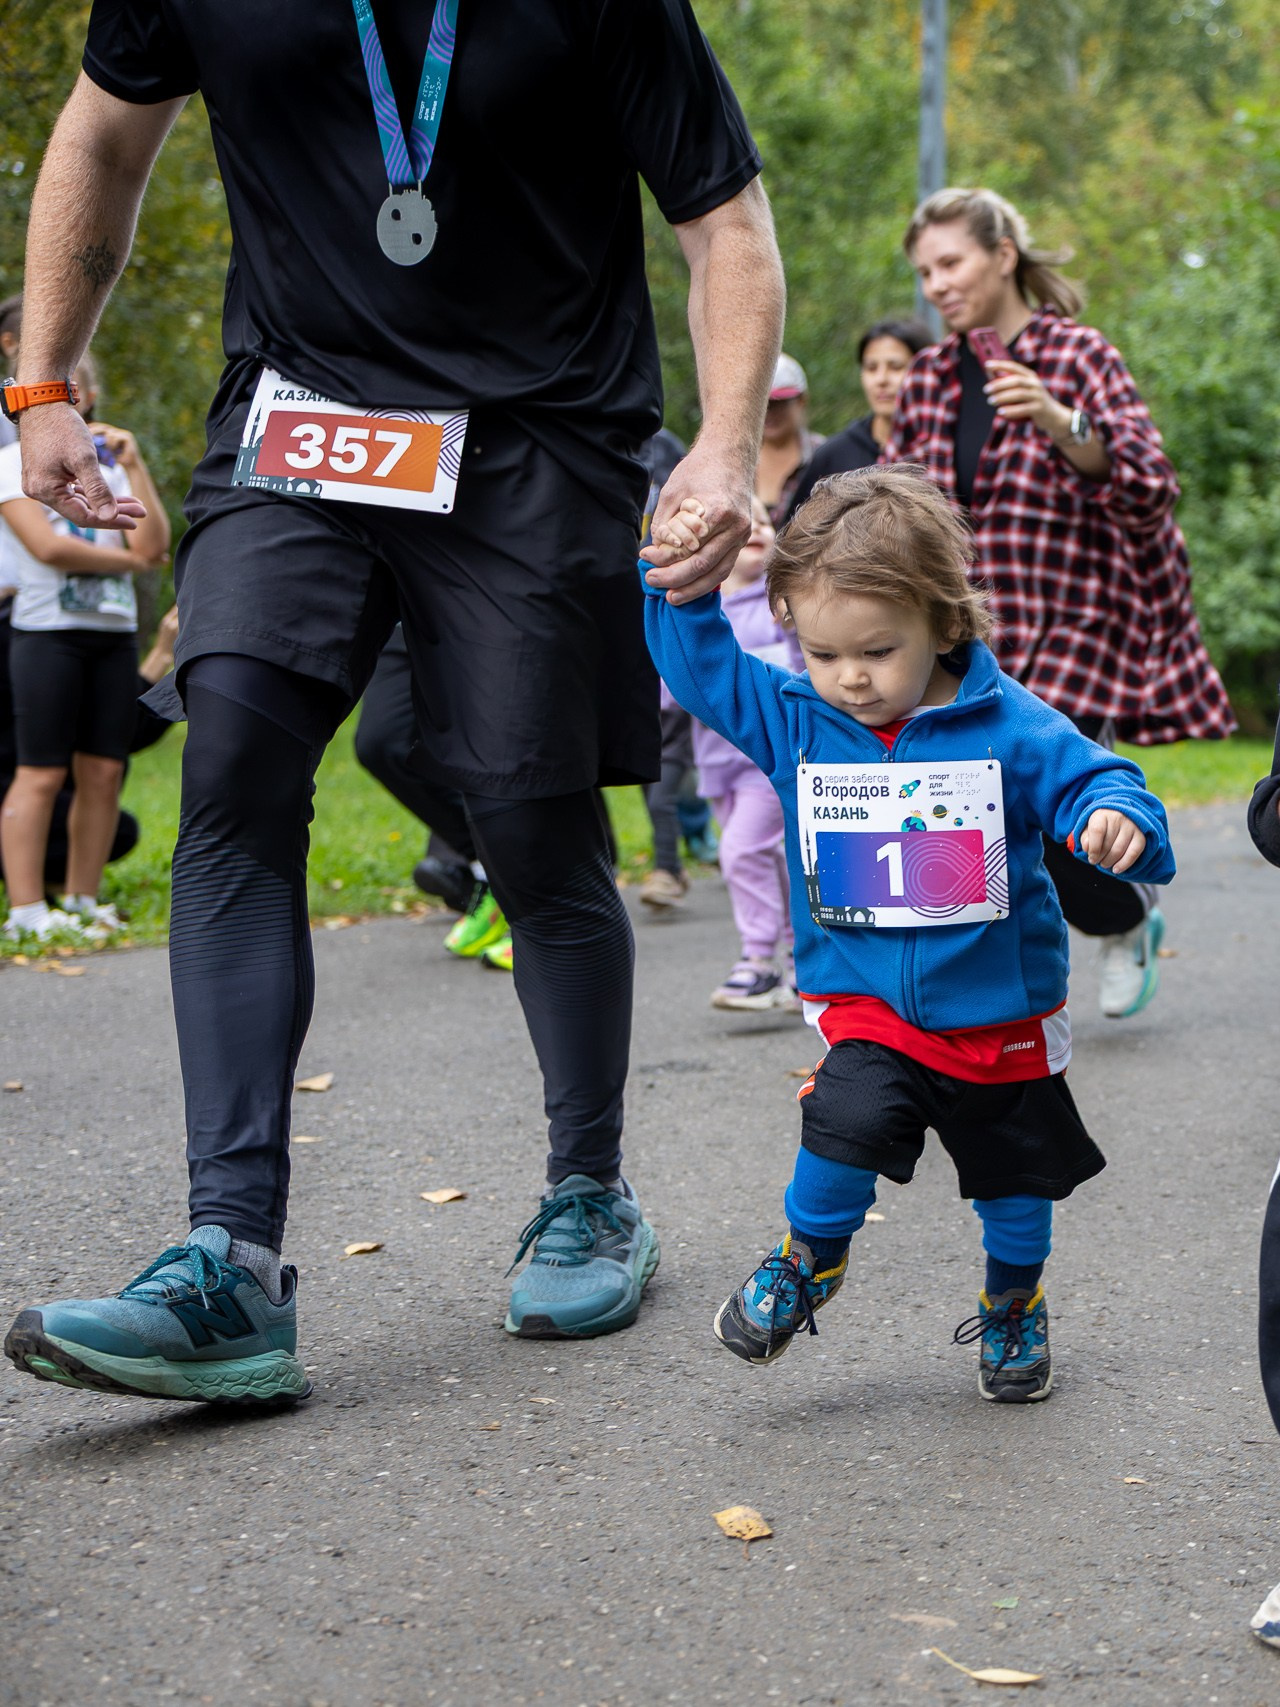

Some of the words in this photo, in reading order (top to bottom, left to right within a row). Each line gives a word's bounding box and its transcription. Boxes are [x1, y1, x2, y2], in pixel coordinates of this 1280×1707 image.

[284, 422, 413, 478] 357
[824, 775, 849, 785] серия
[851, 774, 890, 784] забегов
[813, 806, 869, 820] КАЗАНЬ
[876, 841, 905, 897] 1
